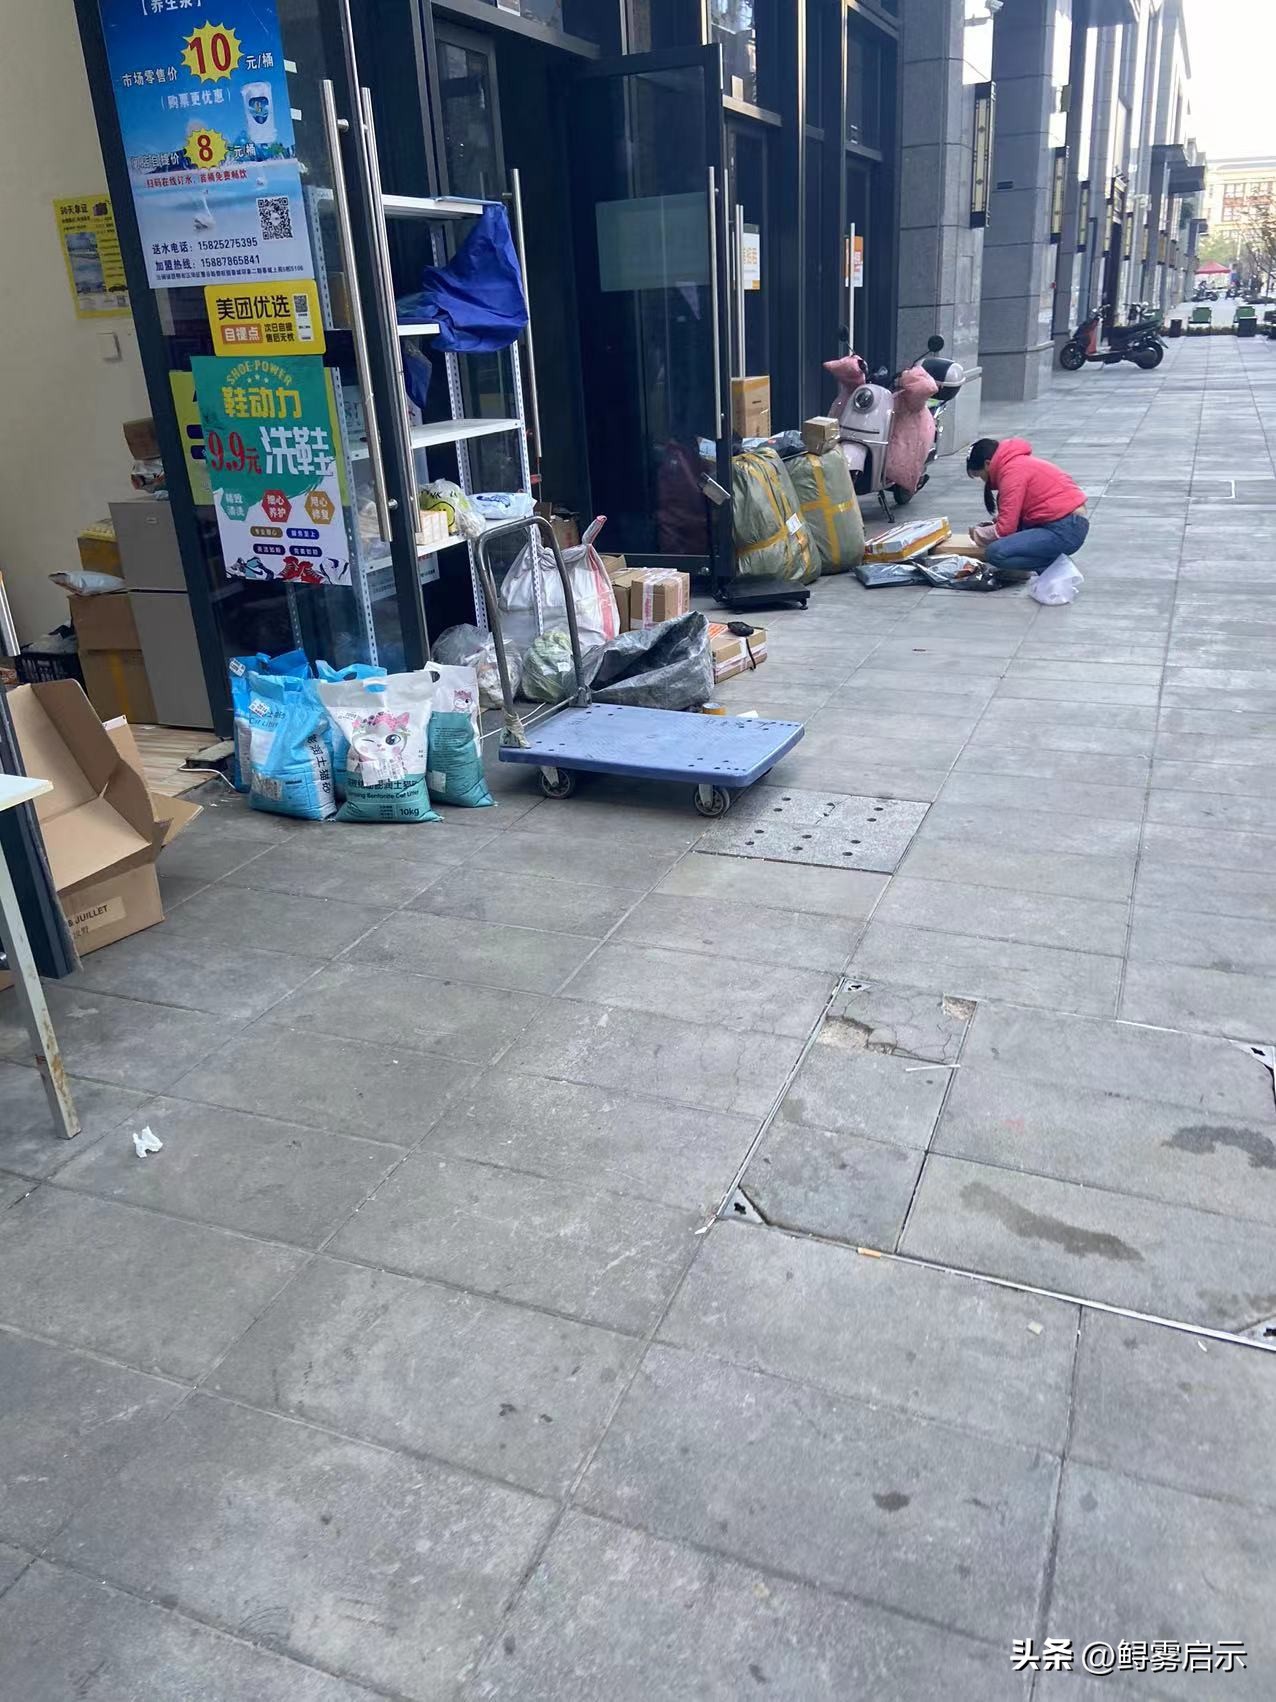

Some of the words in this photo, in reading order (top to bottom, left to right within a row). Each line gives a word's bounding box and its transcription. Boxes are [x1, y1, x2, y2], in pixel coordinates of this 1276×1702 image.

[122, 66, 177, 88] 市场零售价
[189, 32, 232, 75] 10
[245, 52, 274, 70] 元/桶
[197, 134, 213, 162] 8
[216, 294, 291, 321] 美团优选
[224, 326, 260, 342] 自提点
[221, 386, 303, 419] 鞋动力
[208, 431, 262, 475] 9.9元
[259, 426, 336, 477] 洗鞋
[400, 808, 420, 817] 10kg
[75, 904, 108, 924] JUILLET
